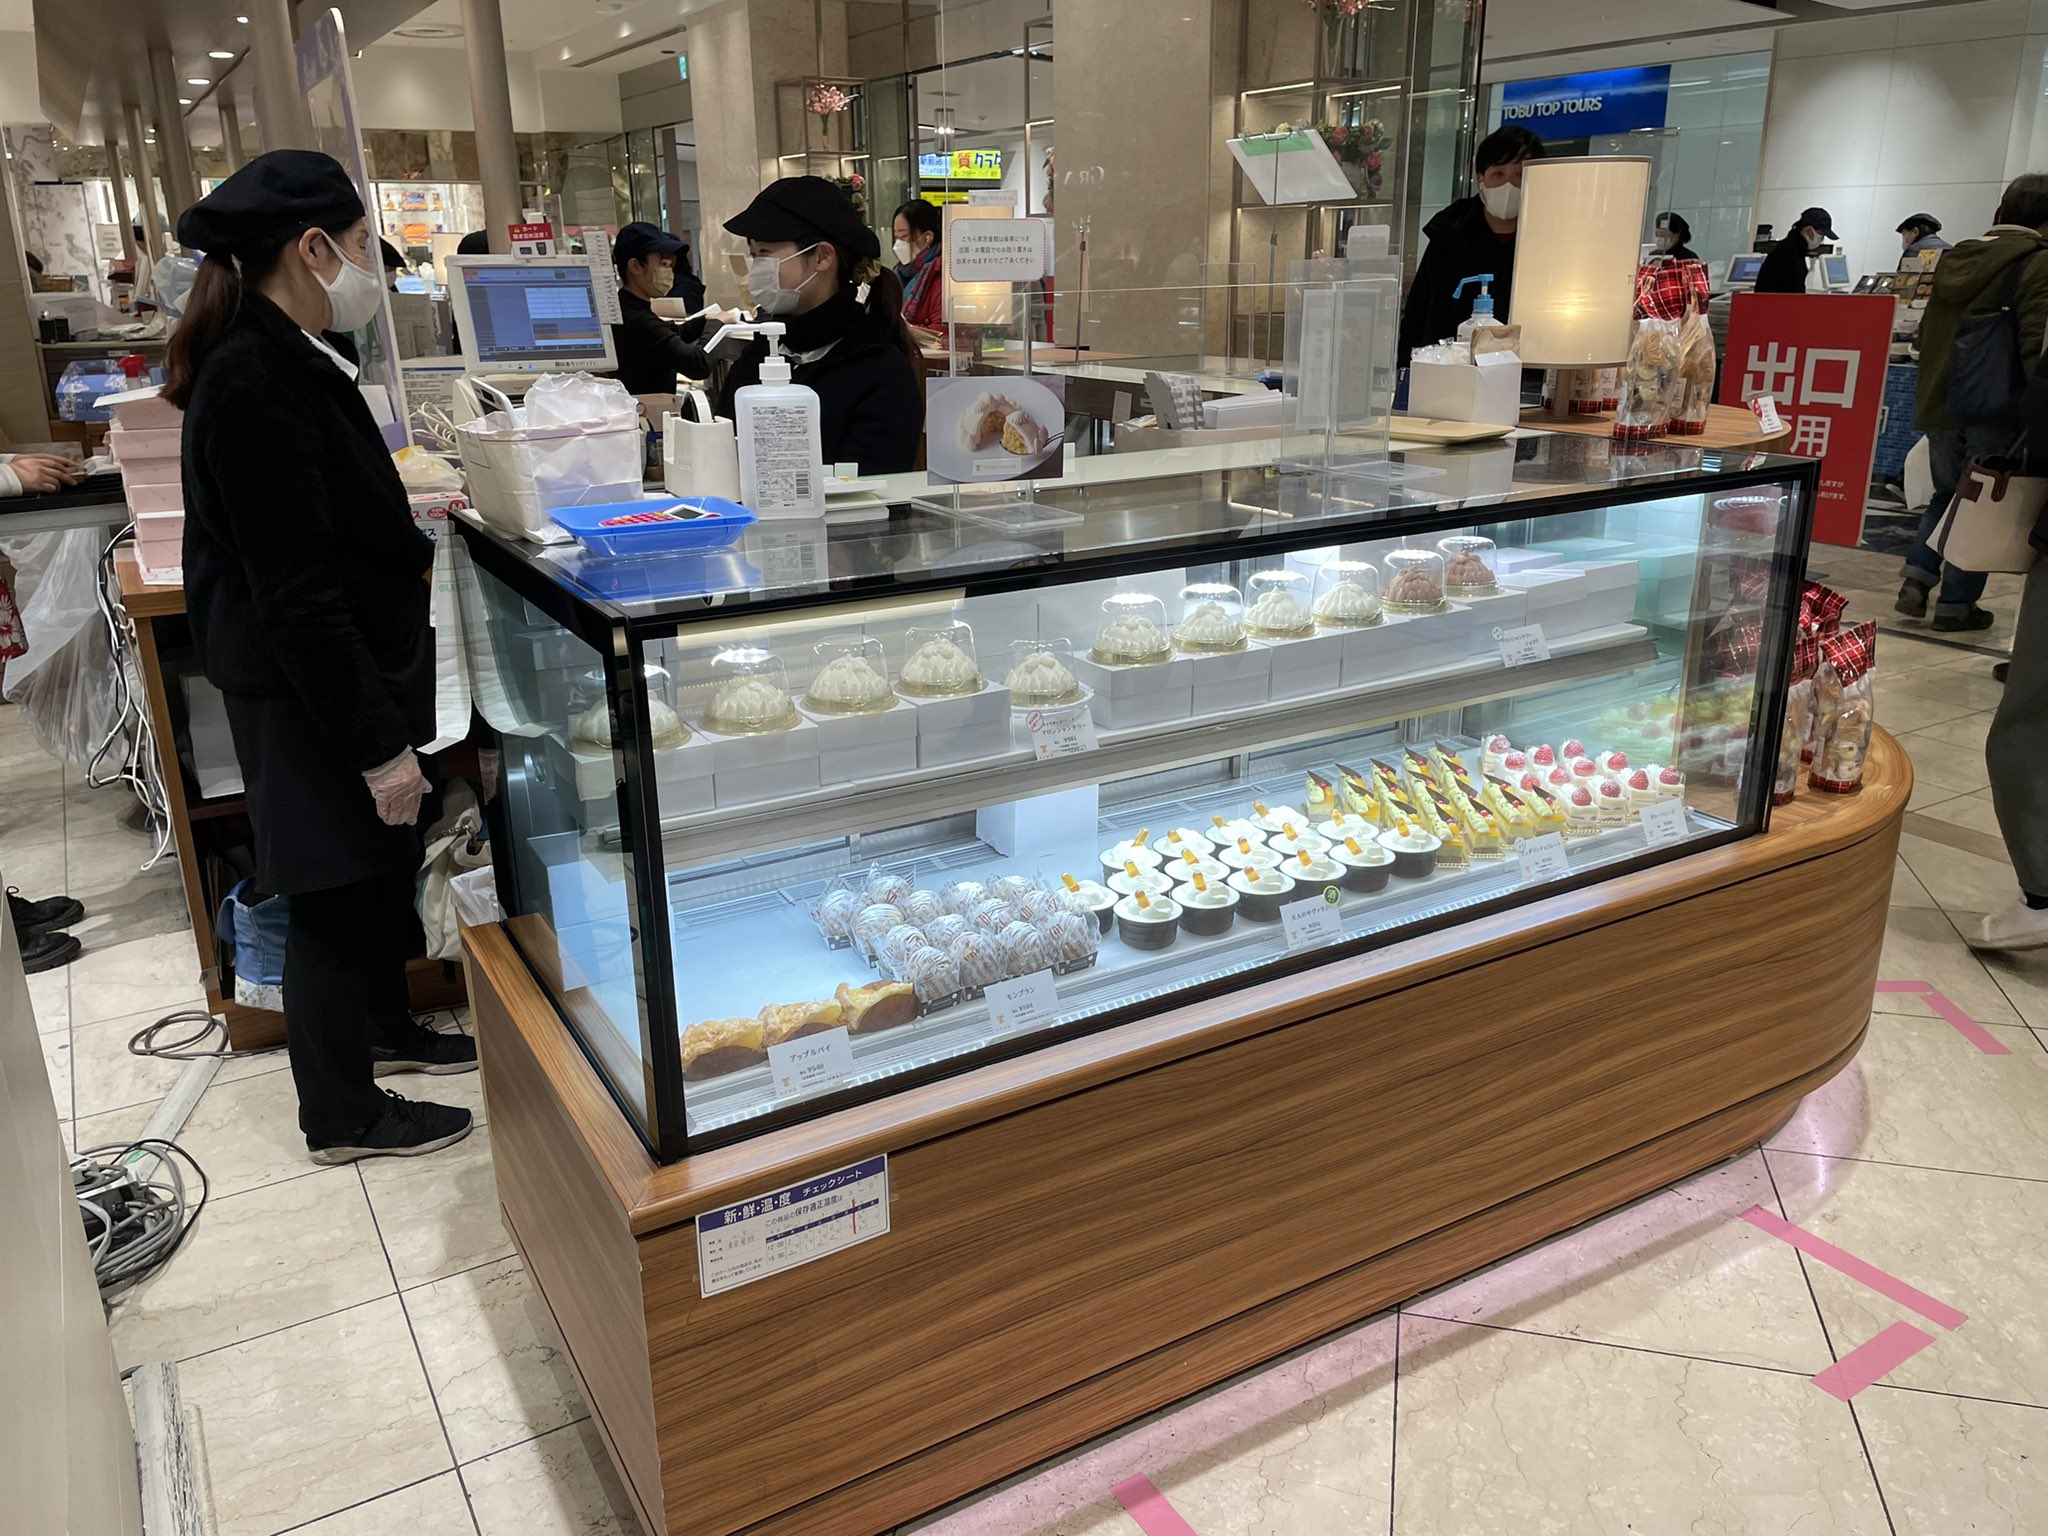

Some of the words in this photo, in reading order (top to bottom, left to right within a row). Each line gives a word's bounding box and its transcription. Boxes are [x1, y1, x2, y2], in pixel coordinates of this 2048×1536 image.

[1503, 104, 1535, 120] TOBU
[1536, 101, 1561, 117] TOP
[1562, 96, 1603, 114] TOURS
[1741, 342, 1861, 409] 出口
[1780, 414, 1831, 457] 用
[1007, 987, 1035, 1000] モンブラン
[789, 1044, 832, 1062] アップルパイ
[807, 1063, 825, 1073] ¥540
[723, 1191, 792, 1225] 新・鮮・温・度
[802, 1170, 862, 1197] チェックシート
[765, 1195, 843, 1227] この商品の保存適正温度は
